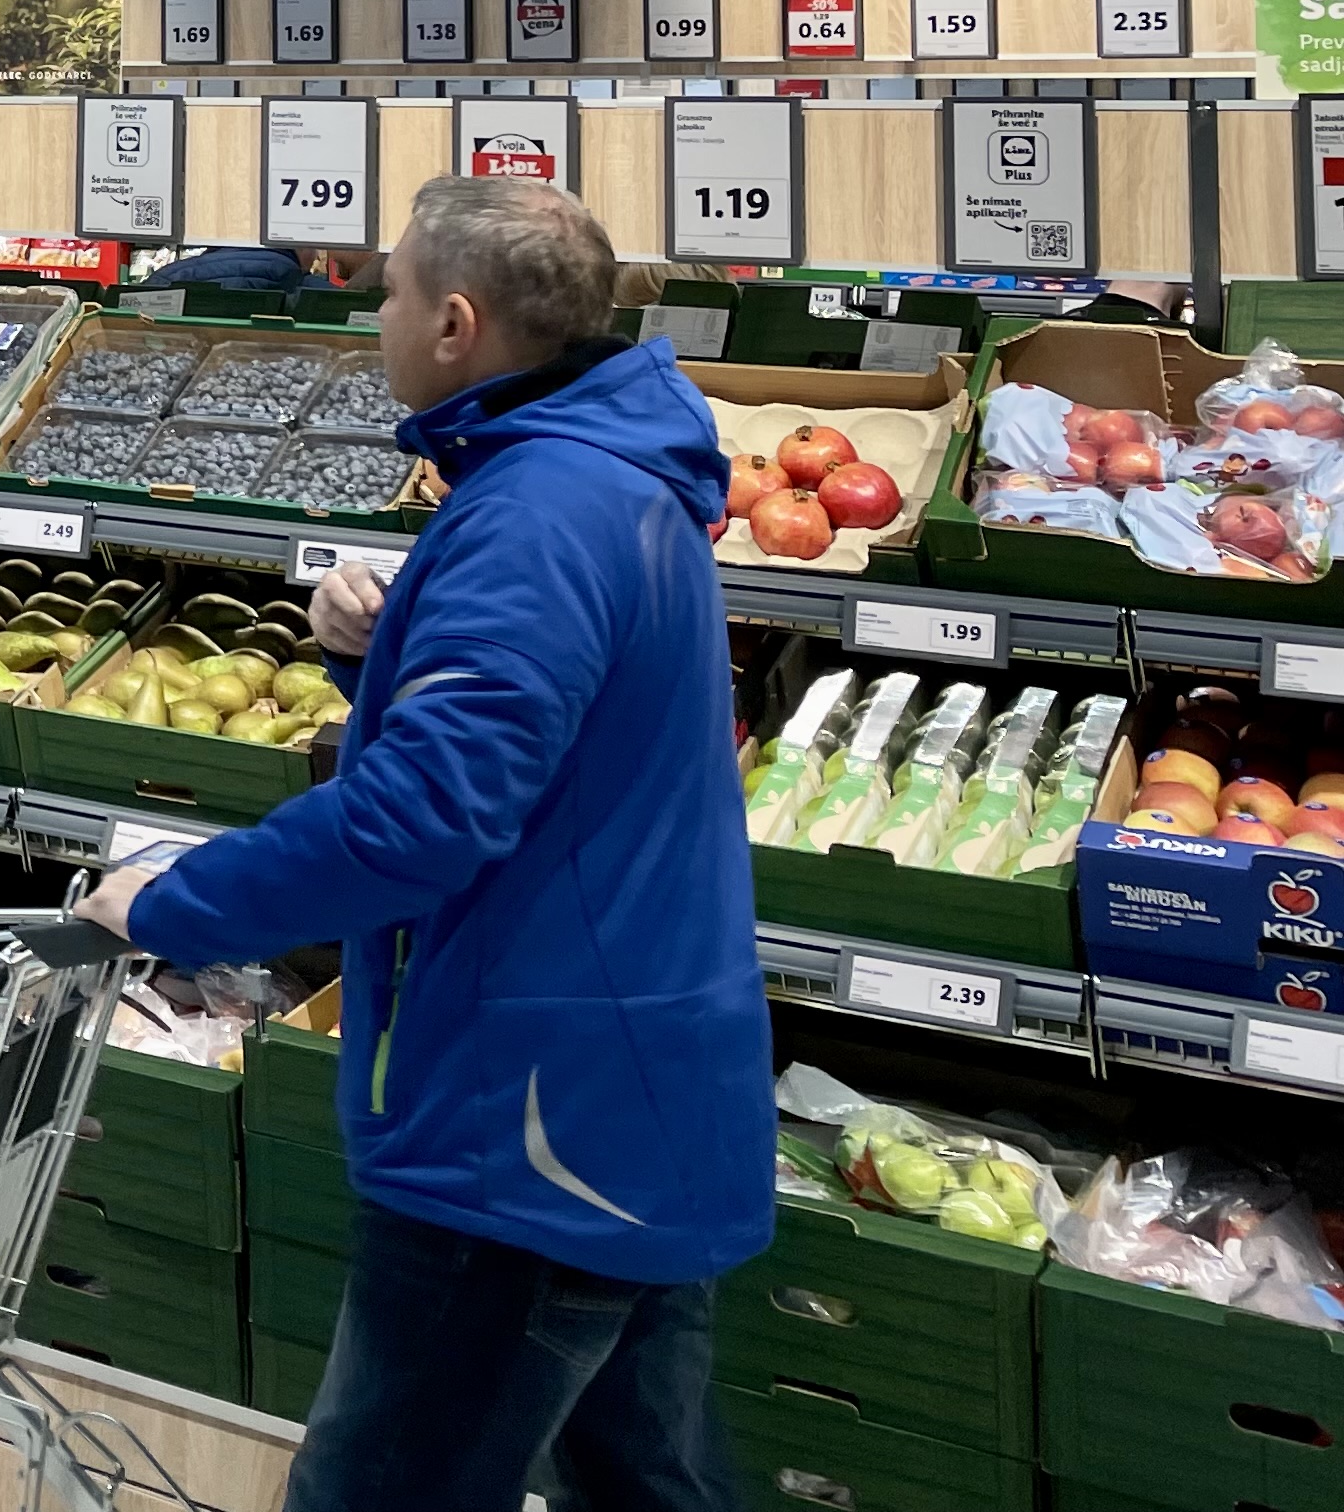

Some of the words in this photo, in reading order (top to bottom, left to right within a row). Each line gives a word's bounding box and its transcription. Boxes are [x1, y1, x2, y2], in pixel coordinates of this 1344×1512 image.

[807, 0, 839, 11] -50%
[528, 20, 555, 32] cena
[656, 19, 706, 37] 0.99
[927, 14, 976, 34] 1.59
[1113, 10, 1168, 32] 2.35
[172, 26, 210, 44] 1.69
[284, 25, 324, 43] 1.69
[416, 23, 456, 41] 1.38
[799, 23, 846, 38] 0.64
[1299, 34, 1344, 50] Prev
[992, 109, 1044, 119] Prihranite
[1012, 119, 1030, 128] več
[495, 138, 526, 152] Tvoja
[118, 154, 138, 164] Plus
[1005, 169, 1032, 180] Plus
[281, 179, 353, 208] 7.99
[966, 194, 980, 205] Še
[982, 196, 1022, 206] nimate
[695, 187, 770, 219] 1.19
[966, 207, 1028, 220] aplikacije?
[43, 523, 74, 538] 2.49
[940, 623, 982, 641] 1.99
[940, 984, 986, 1006] 2.39
